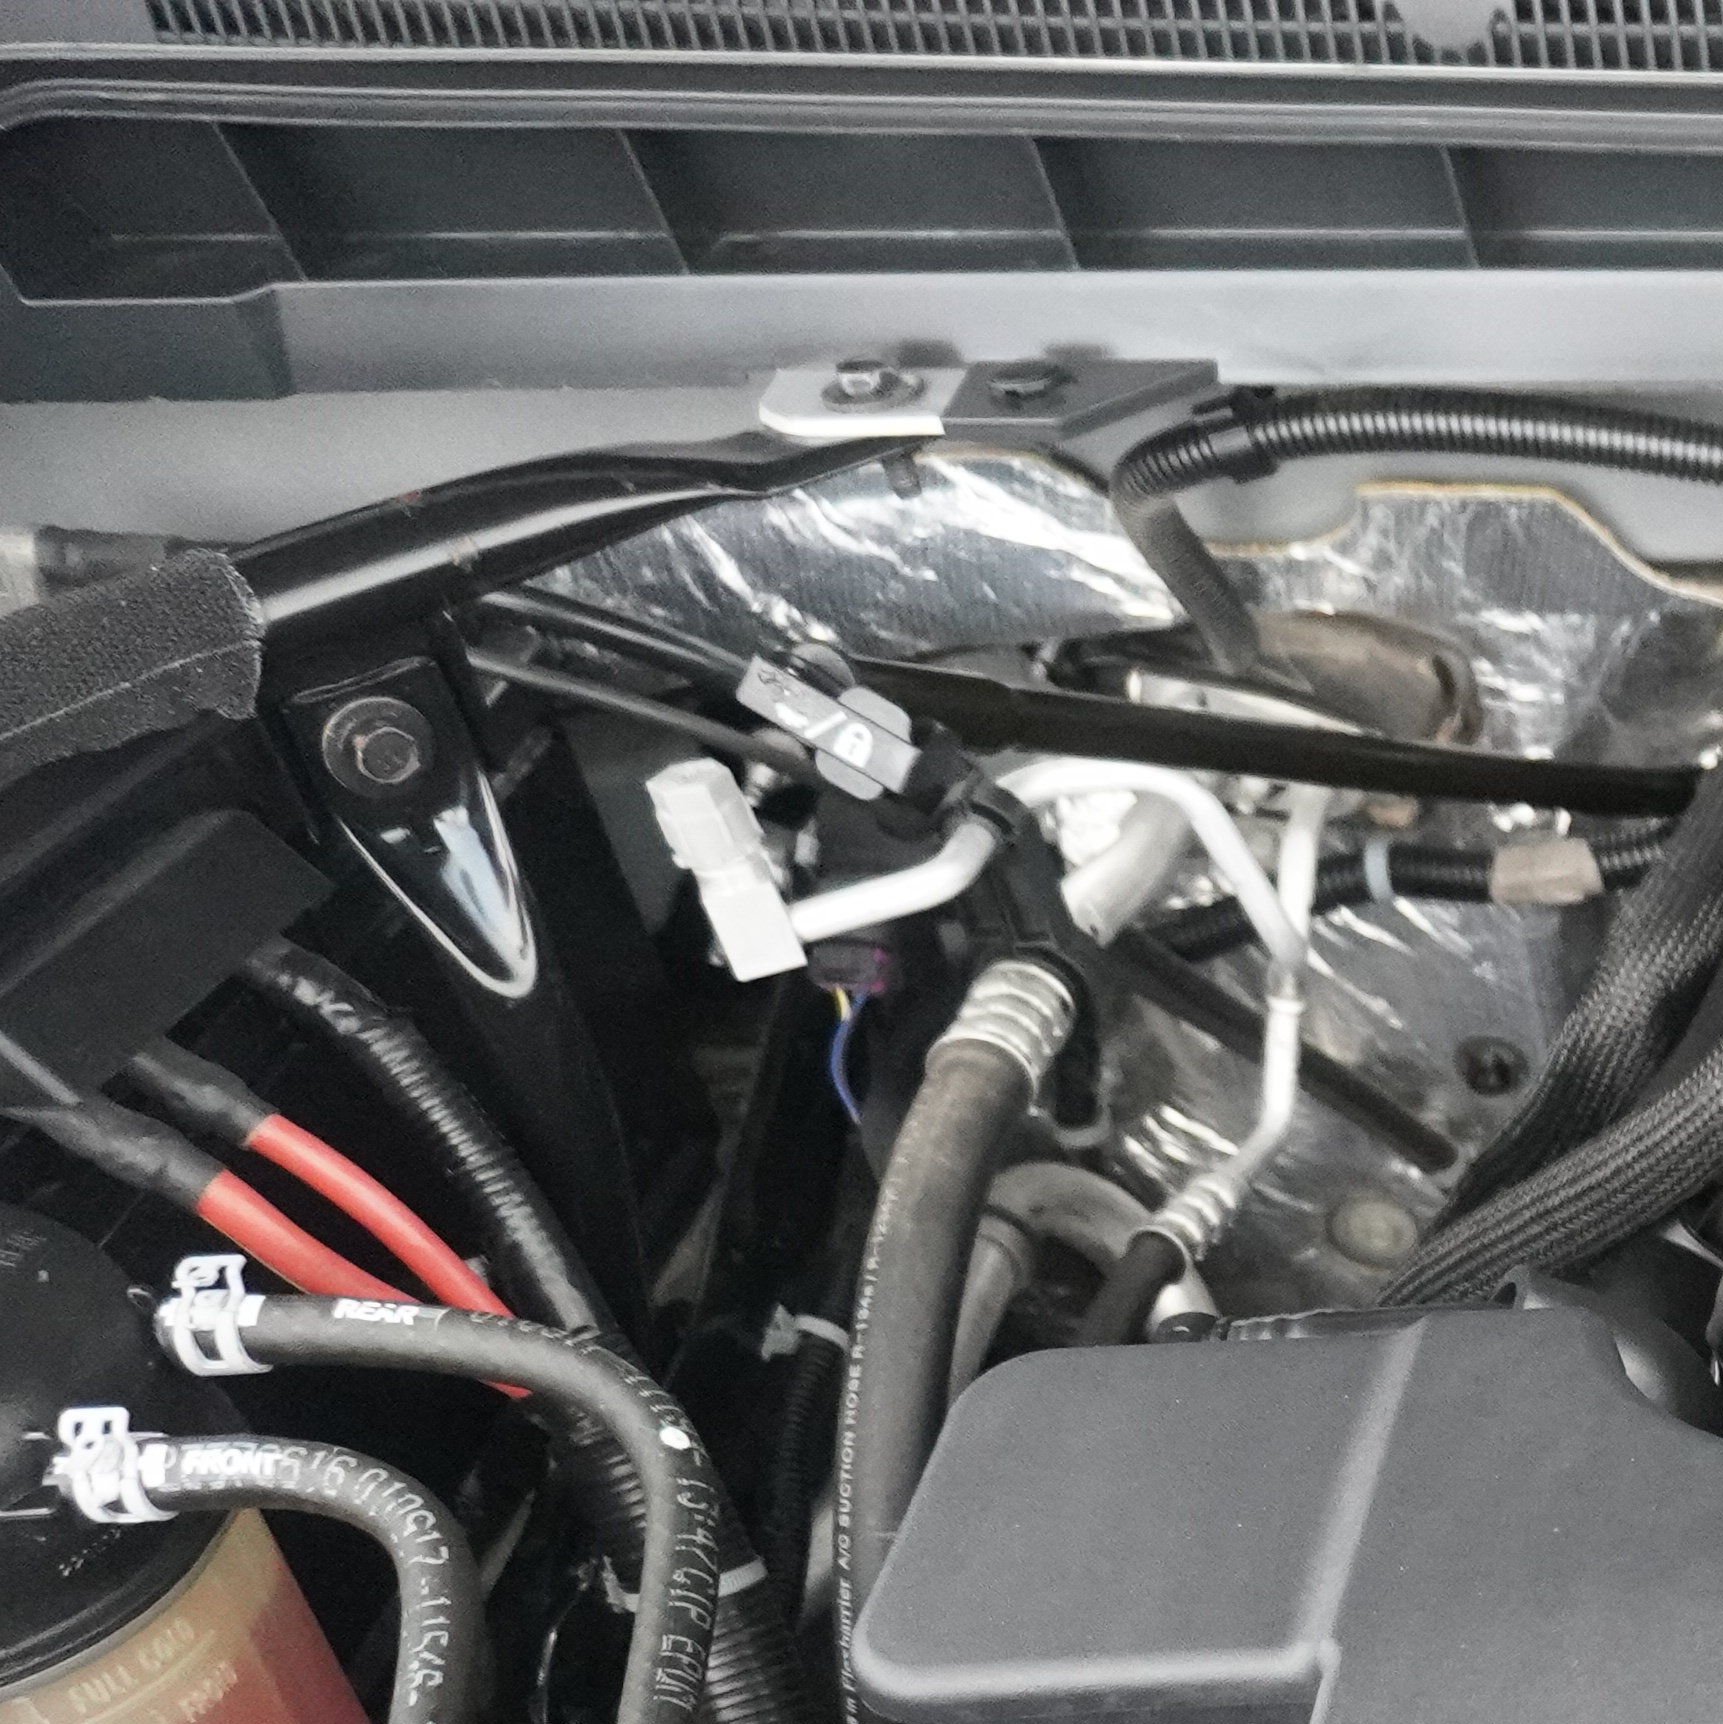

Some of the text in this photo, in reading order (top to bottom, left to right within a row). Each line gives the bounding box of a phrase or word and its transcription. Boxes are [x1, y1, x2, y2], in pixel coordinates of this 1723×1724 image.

[332, 1297, 419, 1327] REAR
[181, 1447, 281, 1478] FRONT
[67, 1663, 140, 1715] FULL
